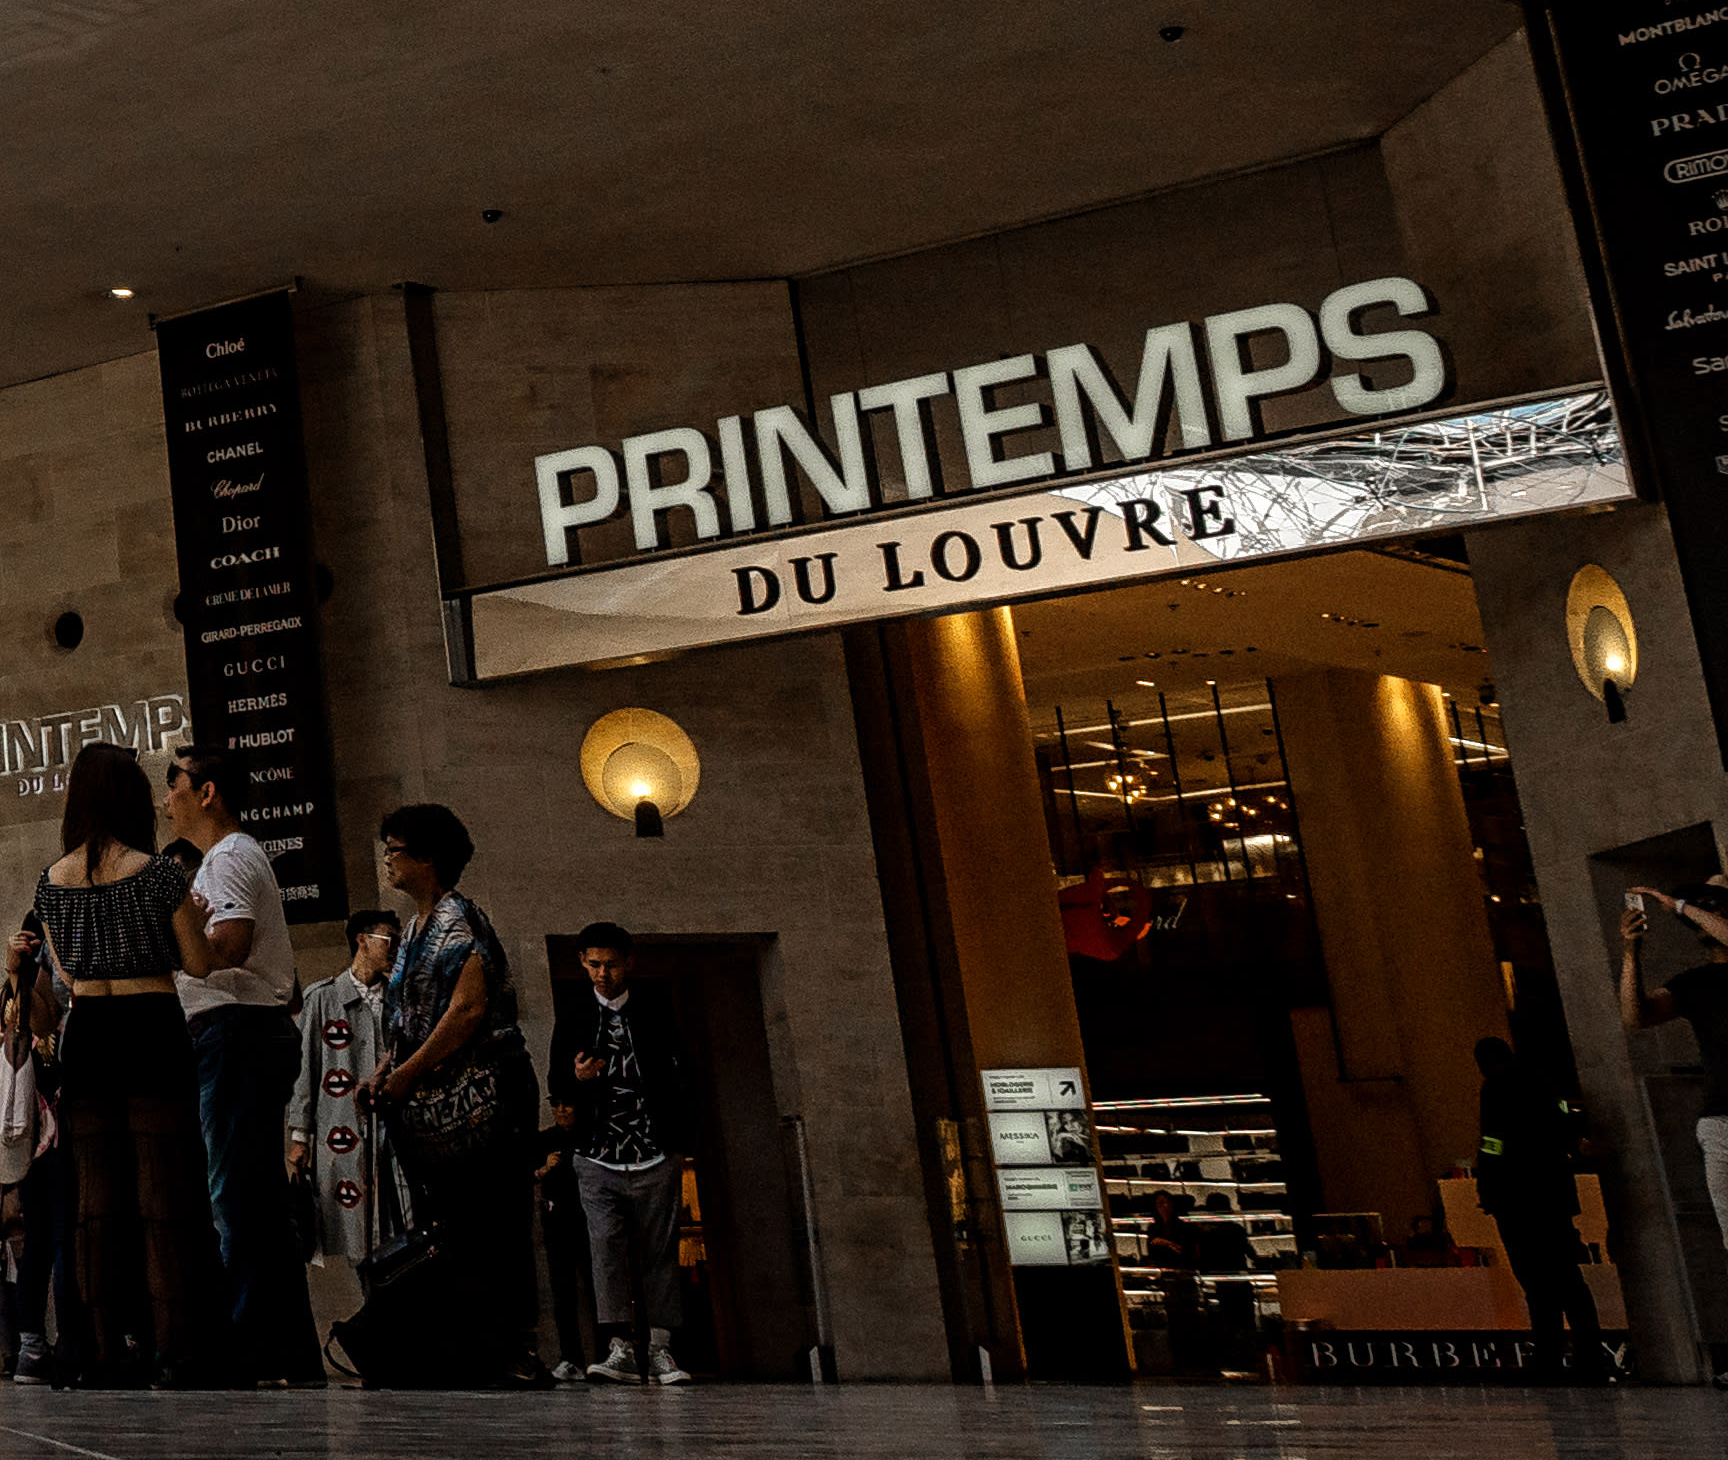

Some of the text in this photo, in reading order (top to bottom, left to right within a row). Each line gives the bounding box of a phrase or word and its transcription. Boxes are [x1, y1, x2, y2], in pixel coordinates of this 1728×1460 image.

[1675, 154, 1728, 179] RIMO
[1663, 253, 1719, 277] SAINT
[205, 337, 246, 360] Chloé
[184, 403, 278, 434] BURBERRY
[533, 274, 1447, 567] PRINTEMPS
[206, 441, 264, 464] CHANEL
[210, 472, 265, 500] Chopard
[221, 515, 262, 534] Dior
[209, 546, 281, 570] COACH
[731, 482, 1238, 617] DU LOUVRE
[200, 616, 303, 644] GIRARD-PERREGAUX
[223, 655, 286, 677] GUCCI
[239, 728, 296, 748] HUBLOT
[17, 775, 44, 797] DU
[250, 766, 296, 784] NCÔME
[240, 801, 315, 822] NGCHAMP
[261, 836, 305, 853] GINES
